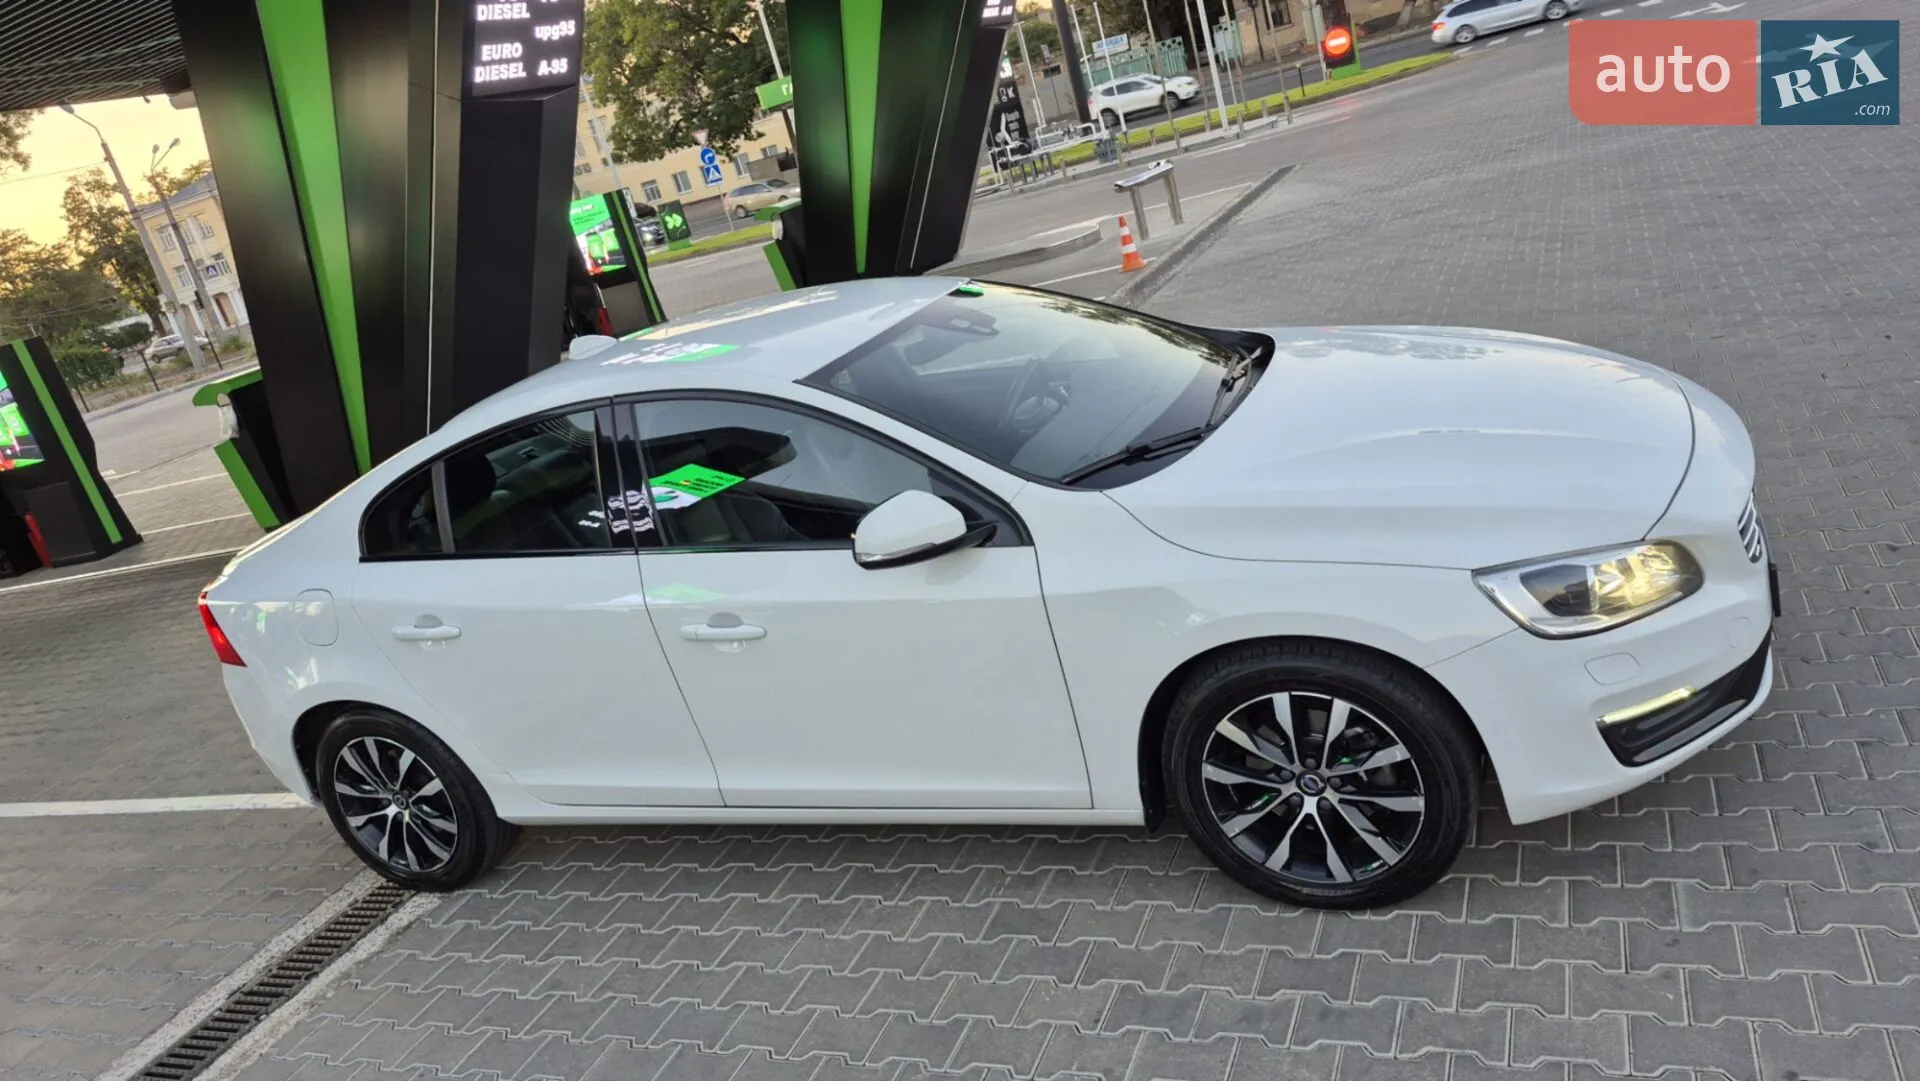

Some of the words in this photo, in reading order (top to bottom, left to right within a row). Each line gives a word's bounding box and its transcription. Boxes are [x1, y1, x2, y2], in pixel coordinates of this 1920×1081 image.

[476, 2, 531, 21] DIESEL
[481, 42, 523, 61] EURO
[474, 62, 527, 83] DIESEL
[537, 57, 568, 76] A-95
